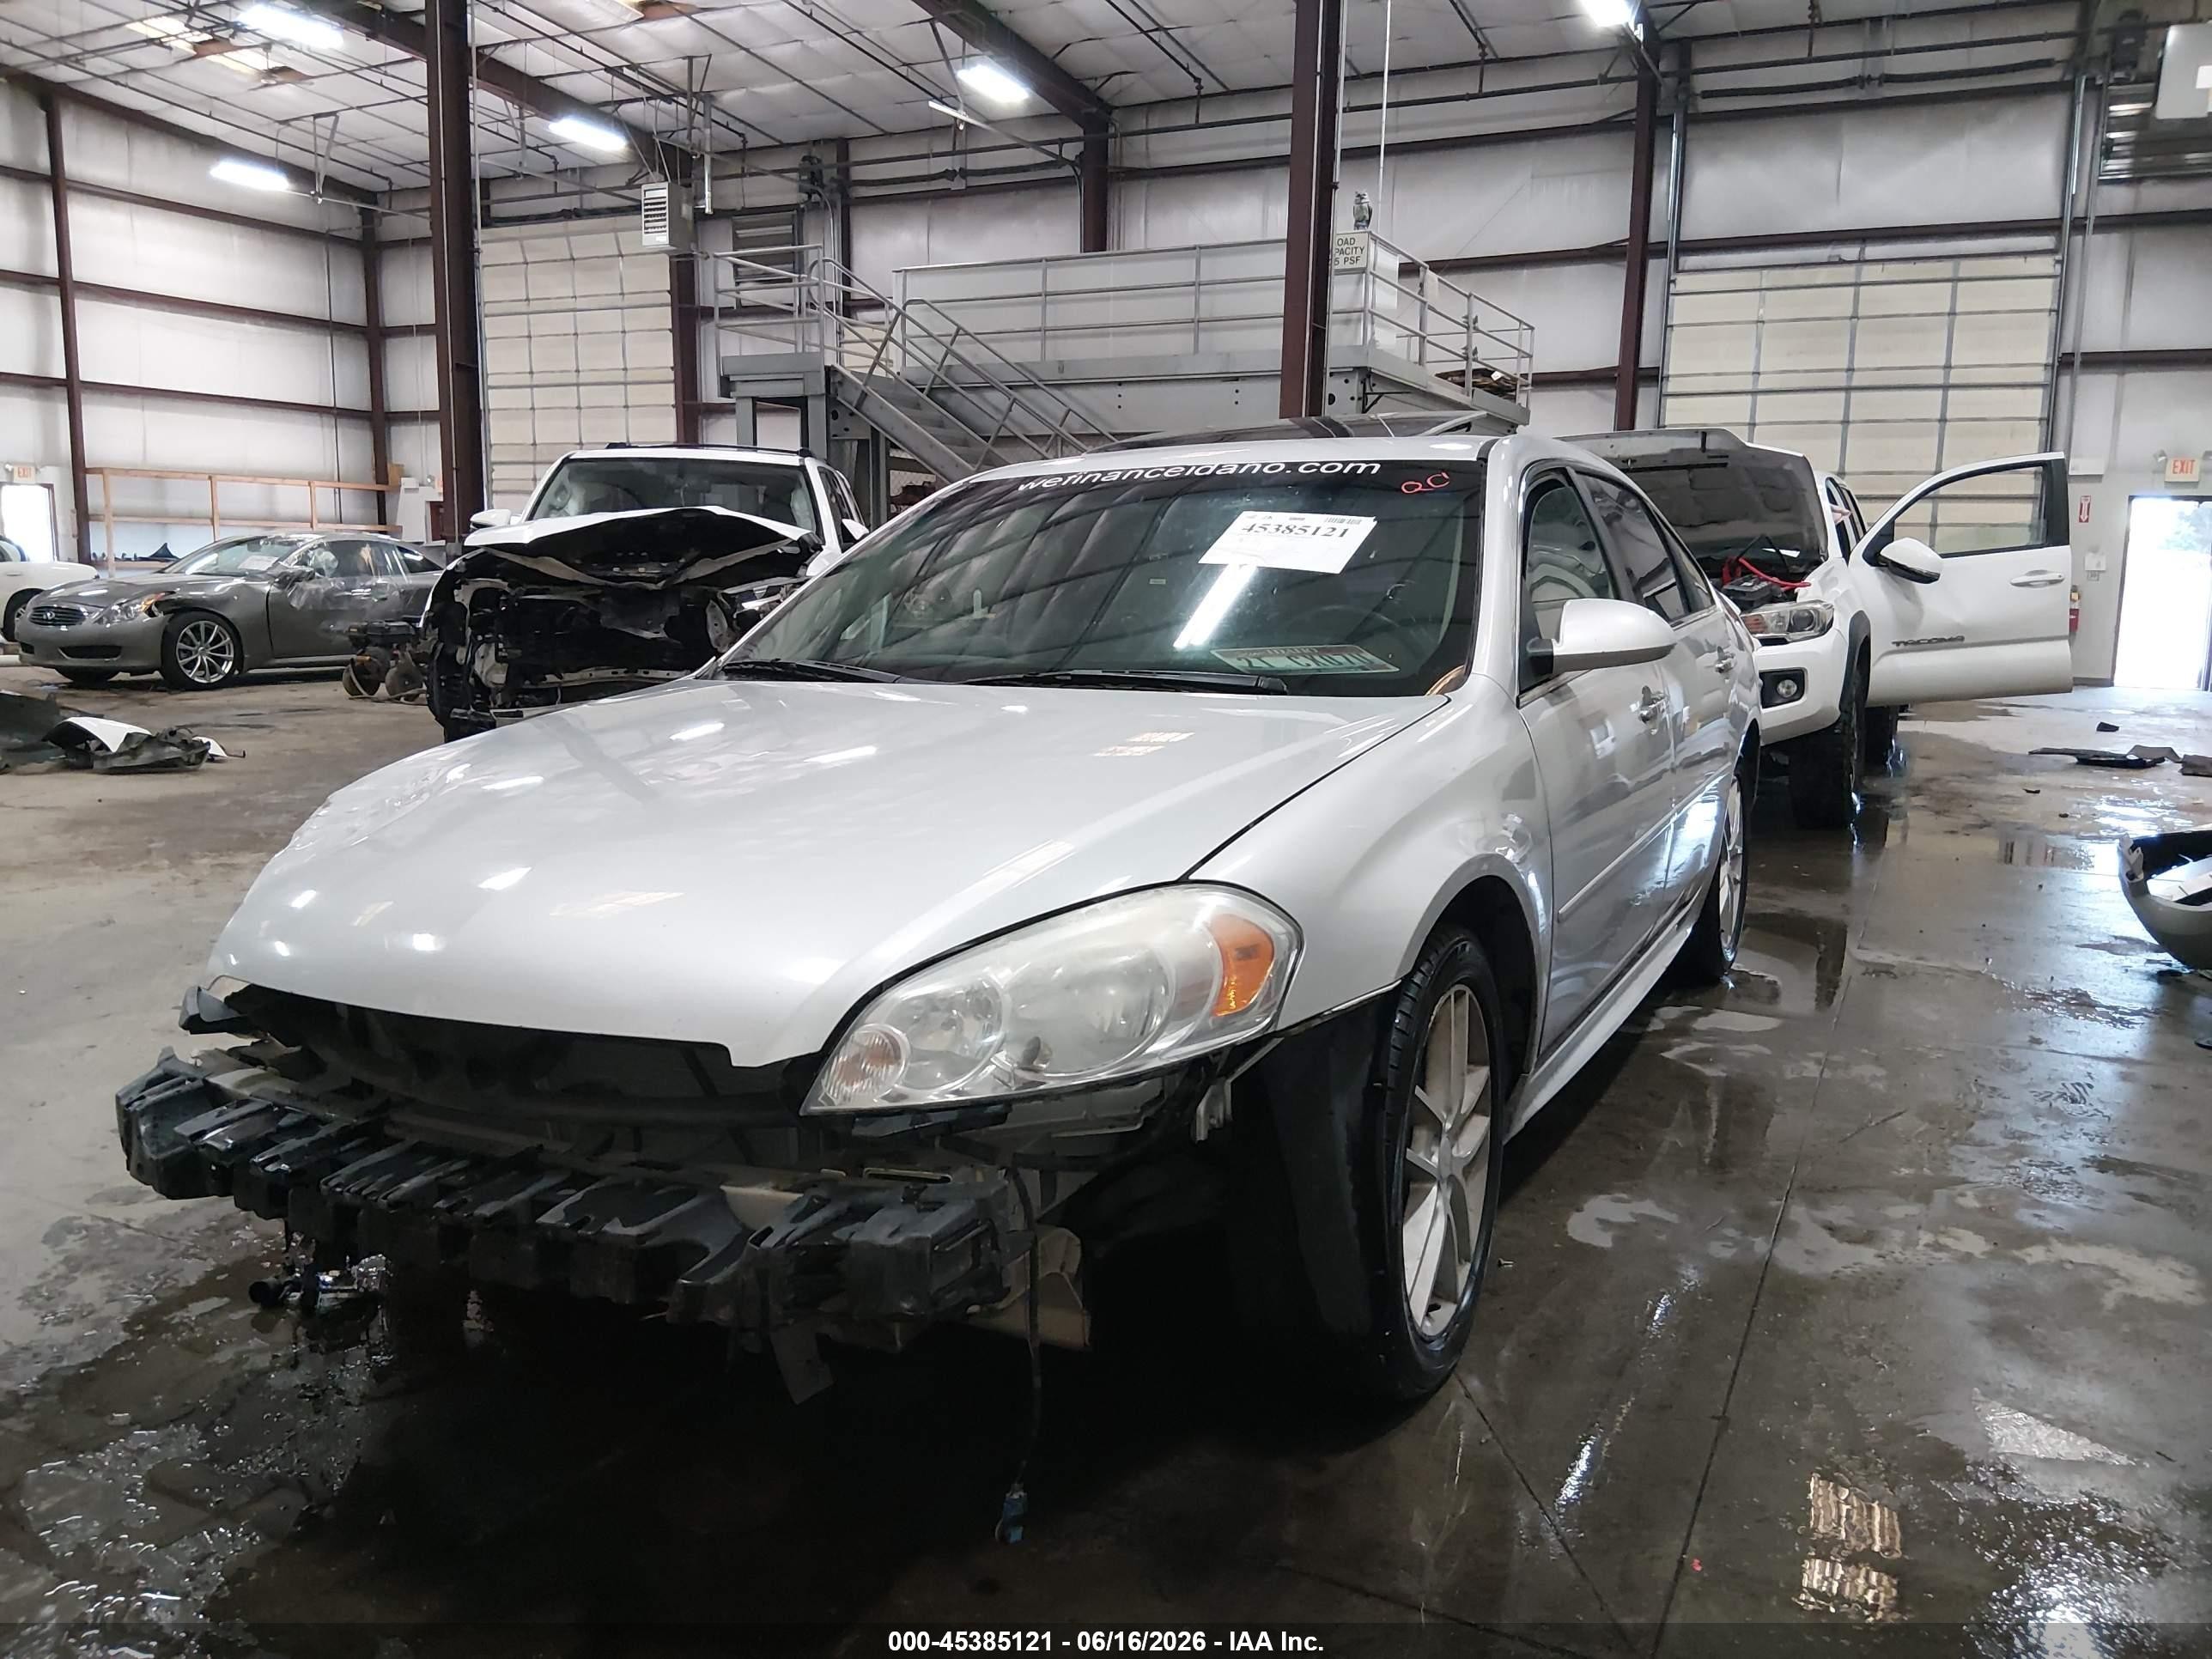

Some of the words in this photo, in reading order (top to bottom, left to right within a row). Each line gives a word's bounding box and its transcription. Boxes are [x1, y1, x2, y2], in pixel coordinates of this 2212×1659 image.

[1336, 237, 1356, 246] OAD
[1334, 246, 1364, 256] PACITY
[1343, 255, 1361, 265] PSF
[2172, 459, 2196, 474] EXIT
[1242, 523, 1350, 538] 45385121
